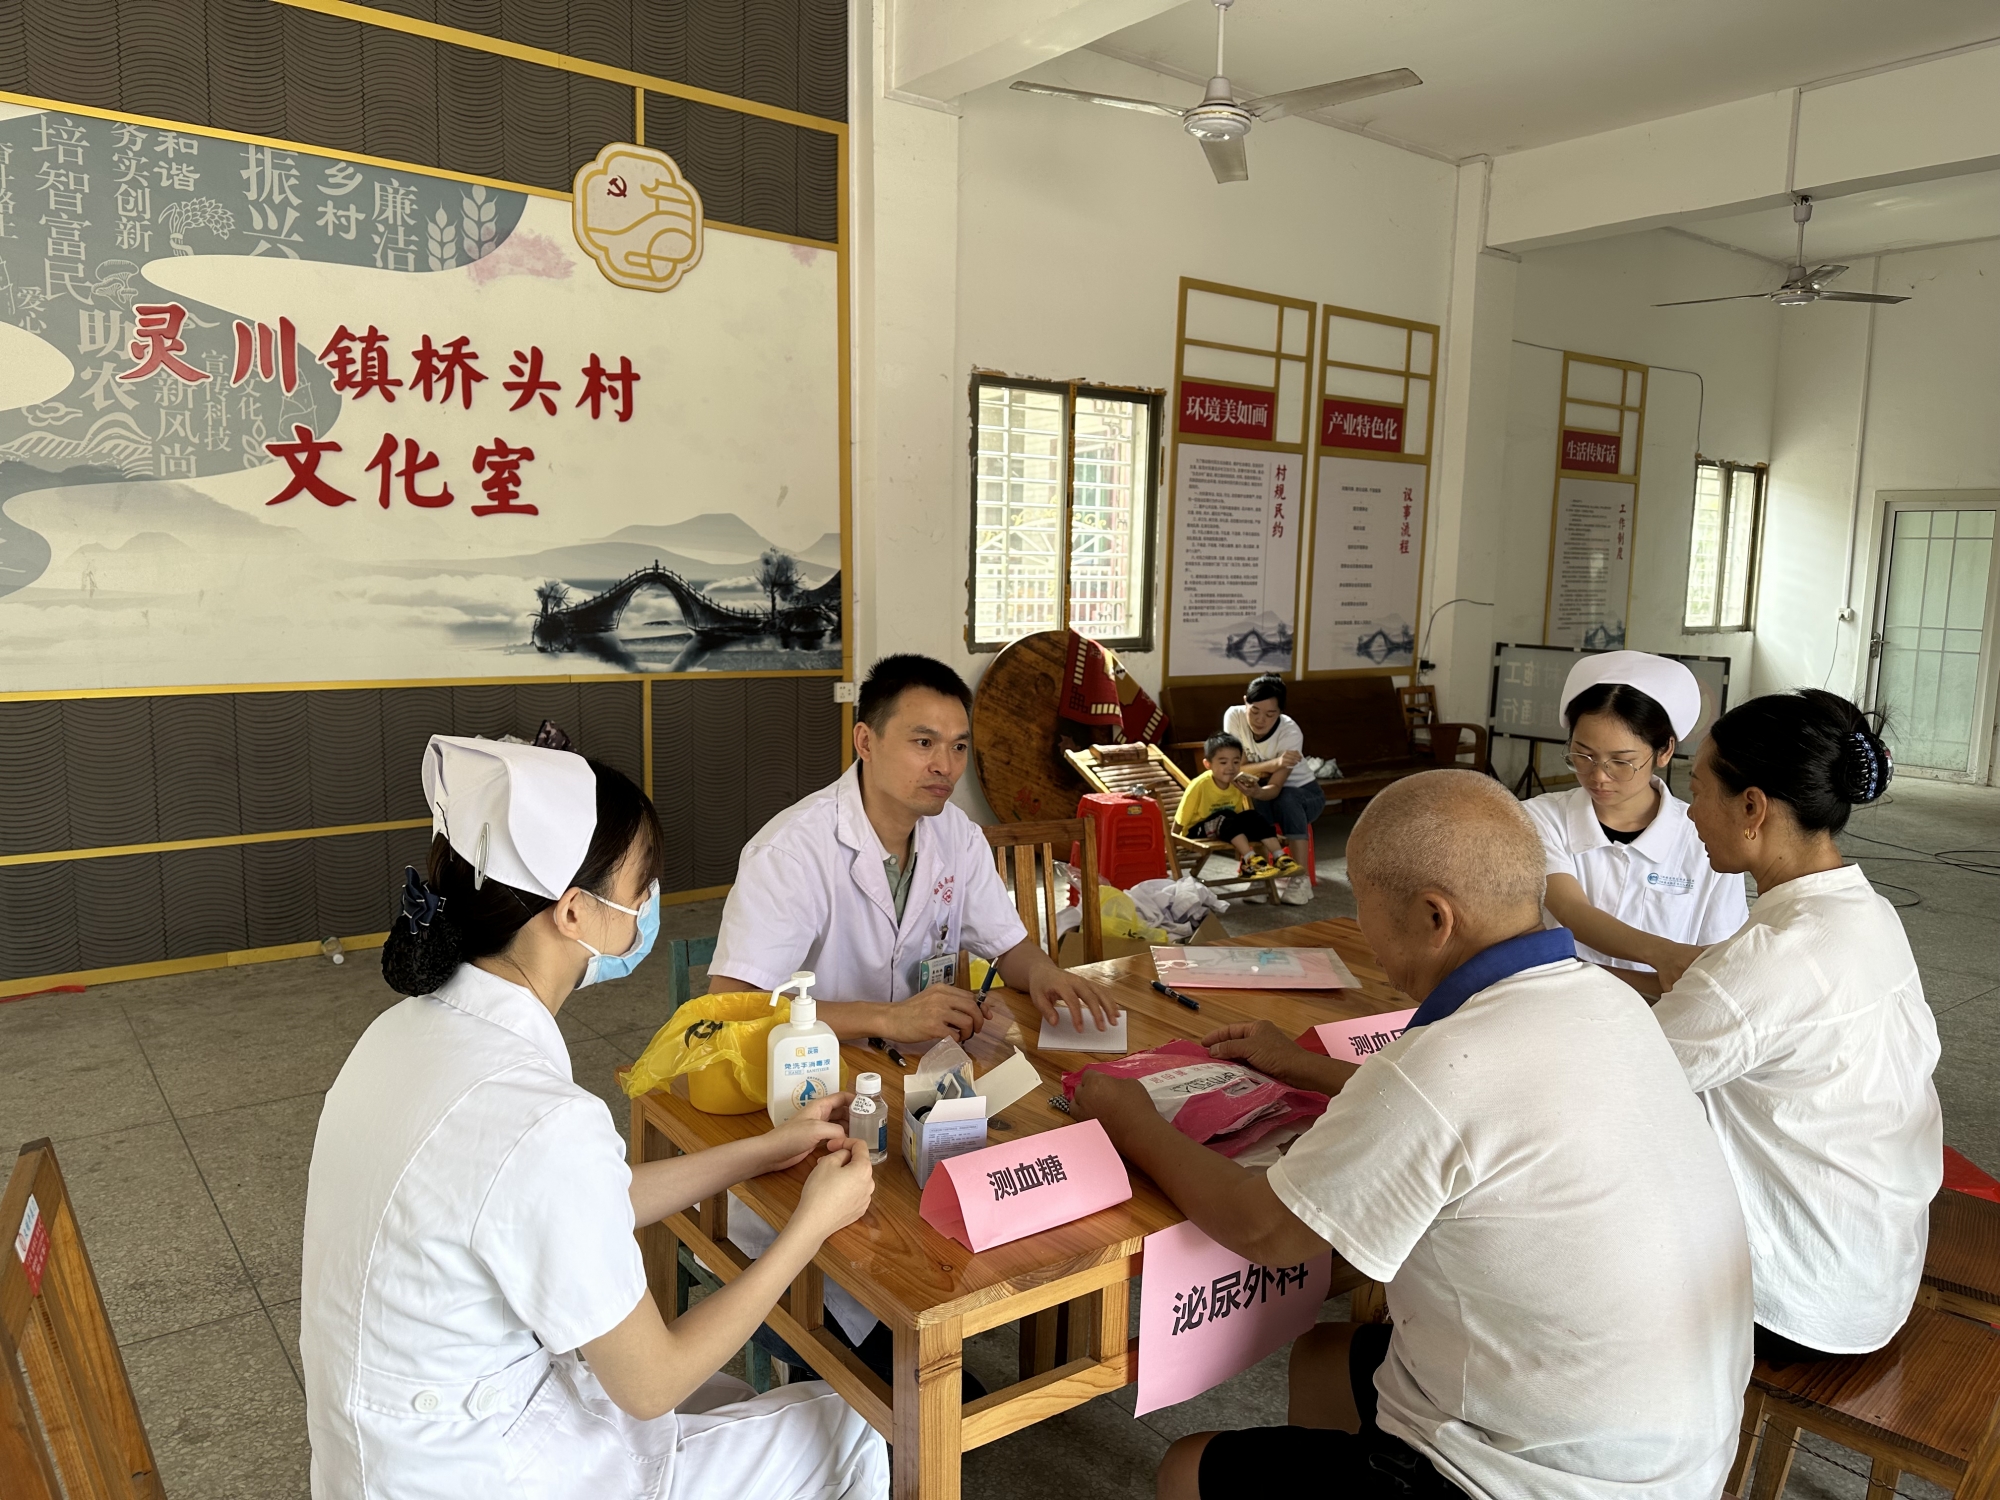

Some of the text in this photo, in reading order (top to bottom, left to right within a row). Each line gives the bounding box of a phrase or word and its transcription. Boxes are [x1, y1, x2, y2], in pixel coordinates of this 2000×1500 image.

[110, 122, 153, 253] 务实创新
[153, 131, 200, 192] 和谐
[32, 114, 94, 305] 培智富民
[240, 144, 304, 260] 振兴
[316, 161, 366, 240] 乡村
[371, 178, 420, 273] 廉洁
[17, 286, 47, 334] 爱心
[77, 309, 141, 412] 助农
[116, 302, 641, 422] 灵川镇桥头村
[201, 350, 232, 452] 宣传科技
[1186, 396, 1268, 428] 环境美如画
[1327, 411, 1398, 440] 产业特色化
[265, 423, 539, 517] 文化室
[1565, 440, 1617, 464] 生活传好话
[1271, 464, 1287, 538] 村规民约
[1617, 504, 1627, 560] 工作制度
[986, 1154, 1068, 1202] 测血糖
[1172, 1262, 1309, 1336] 泌尿外科
